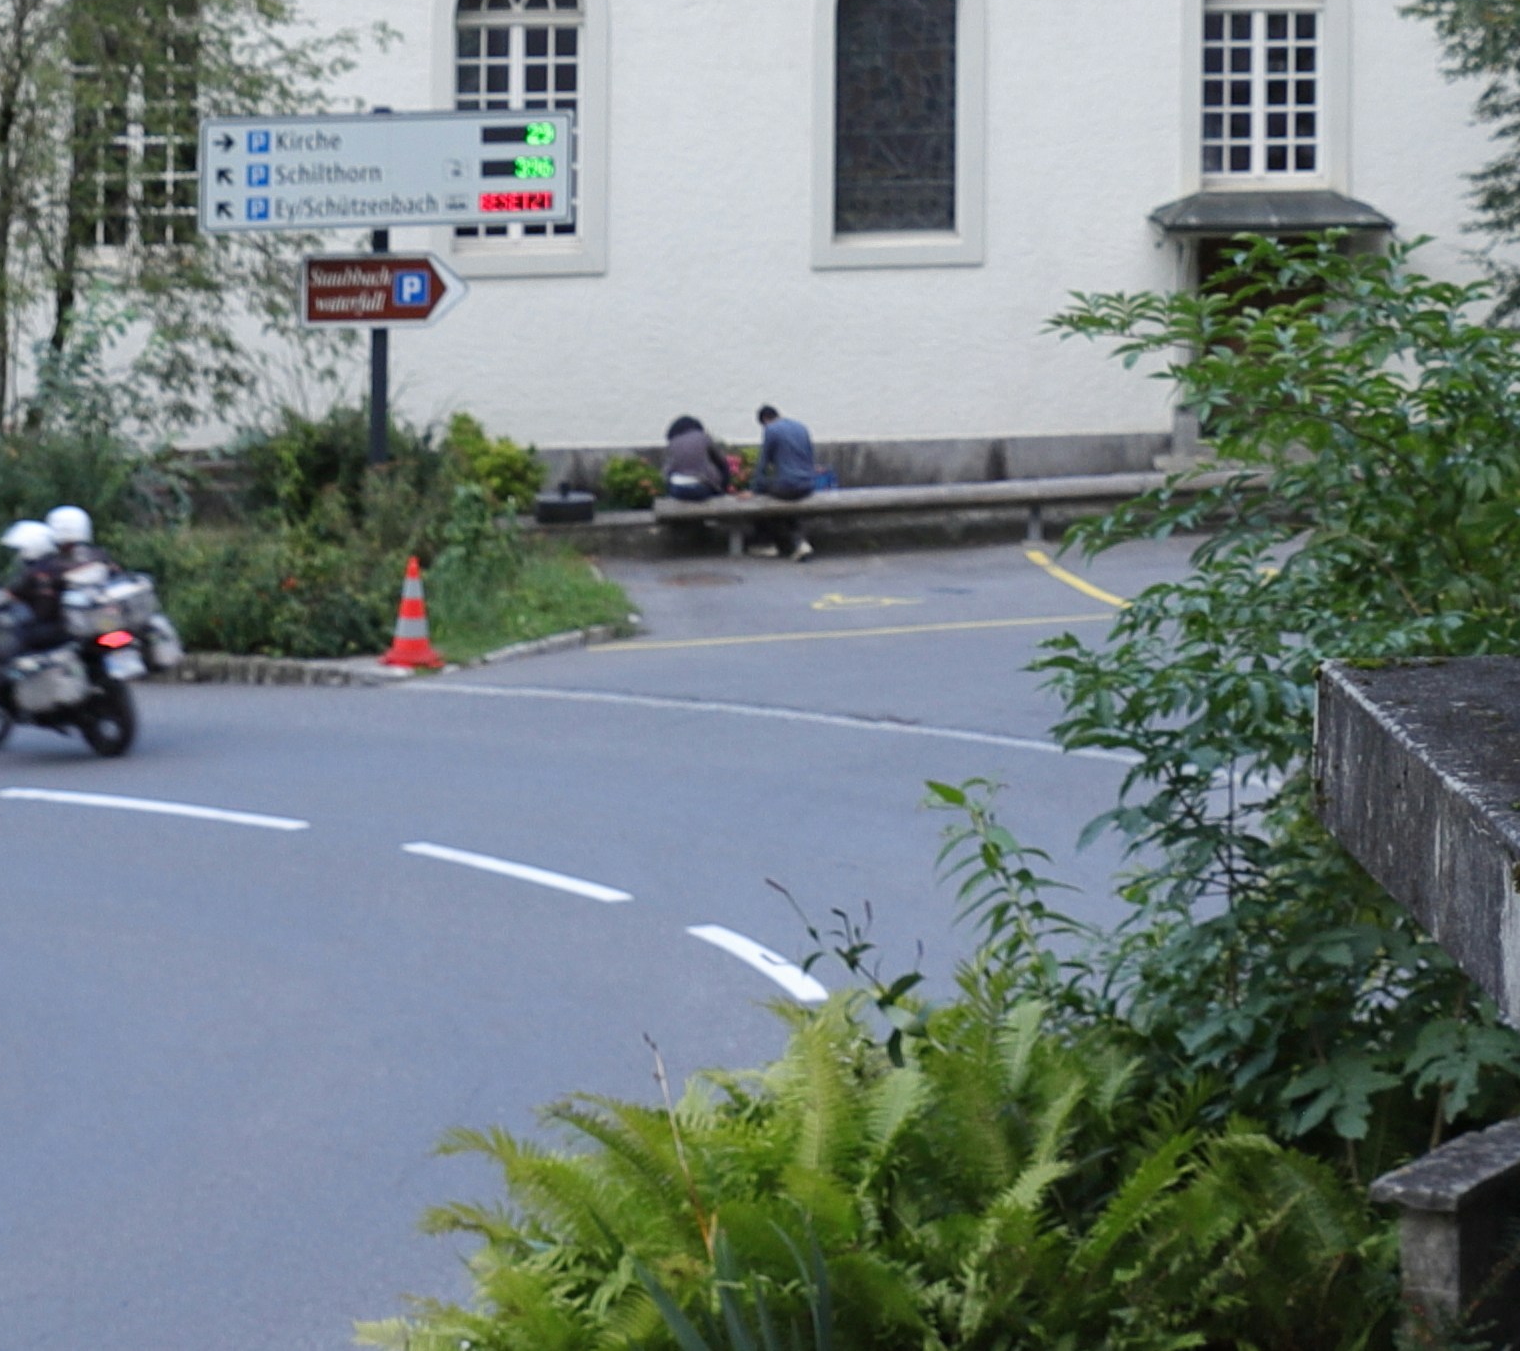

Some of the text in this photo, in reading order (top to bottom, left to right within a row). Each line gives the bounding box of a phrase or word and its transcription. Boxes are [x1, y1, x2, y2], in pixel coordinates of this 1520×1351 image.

[275, 129, 342, 151] Kirche
[275, 162, 383, 185] Schilthorn
[275, 192, 439, 224] Ey/Schützenbach
[310, 265, 422, 303] Staubbach P
[314, 290, 387, 317] waterfall
